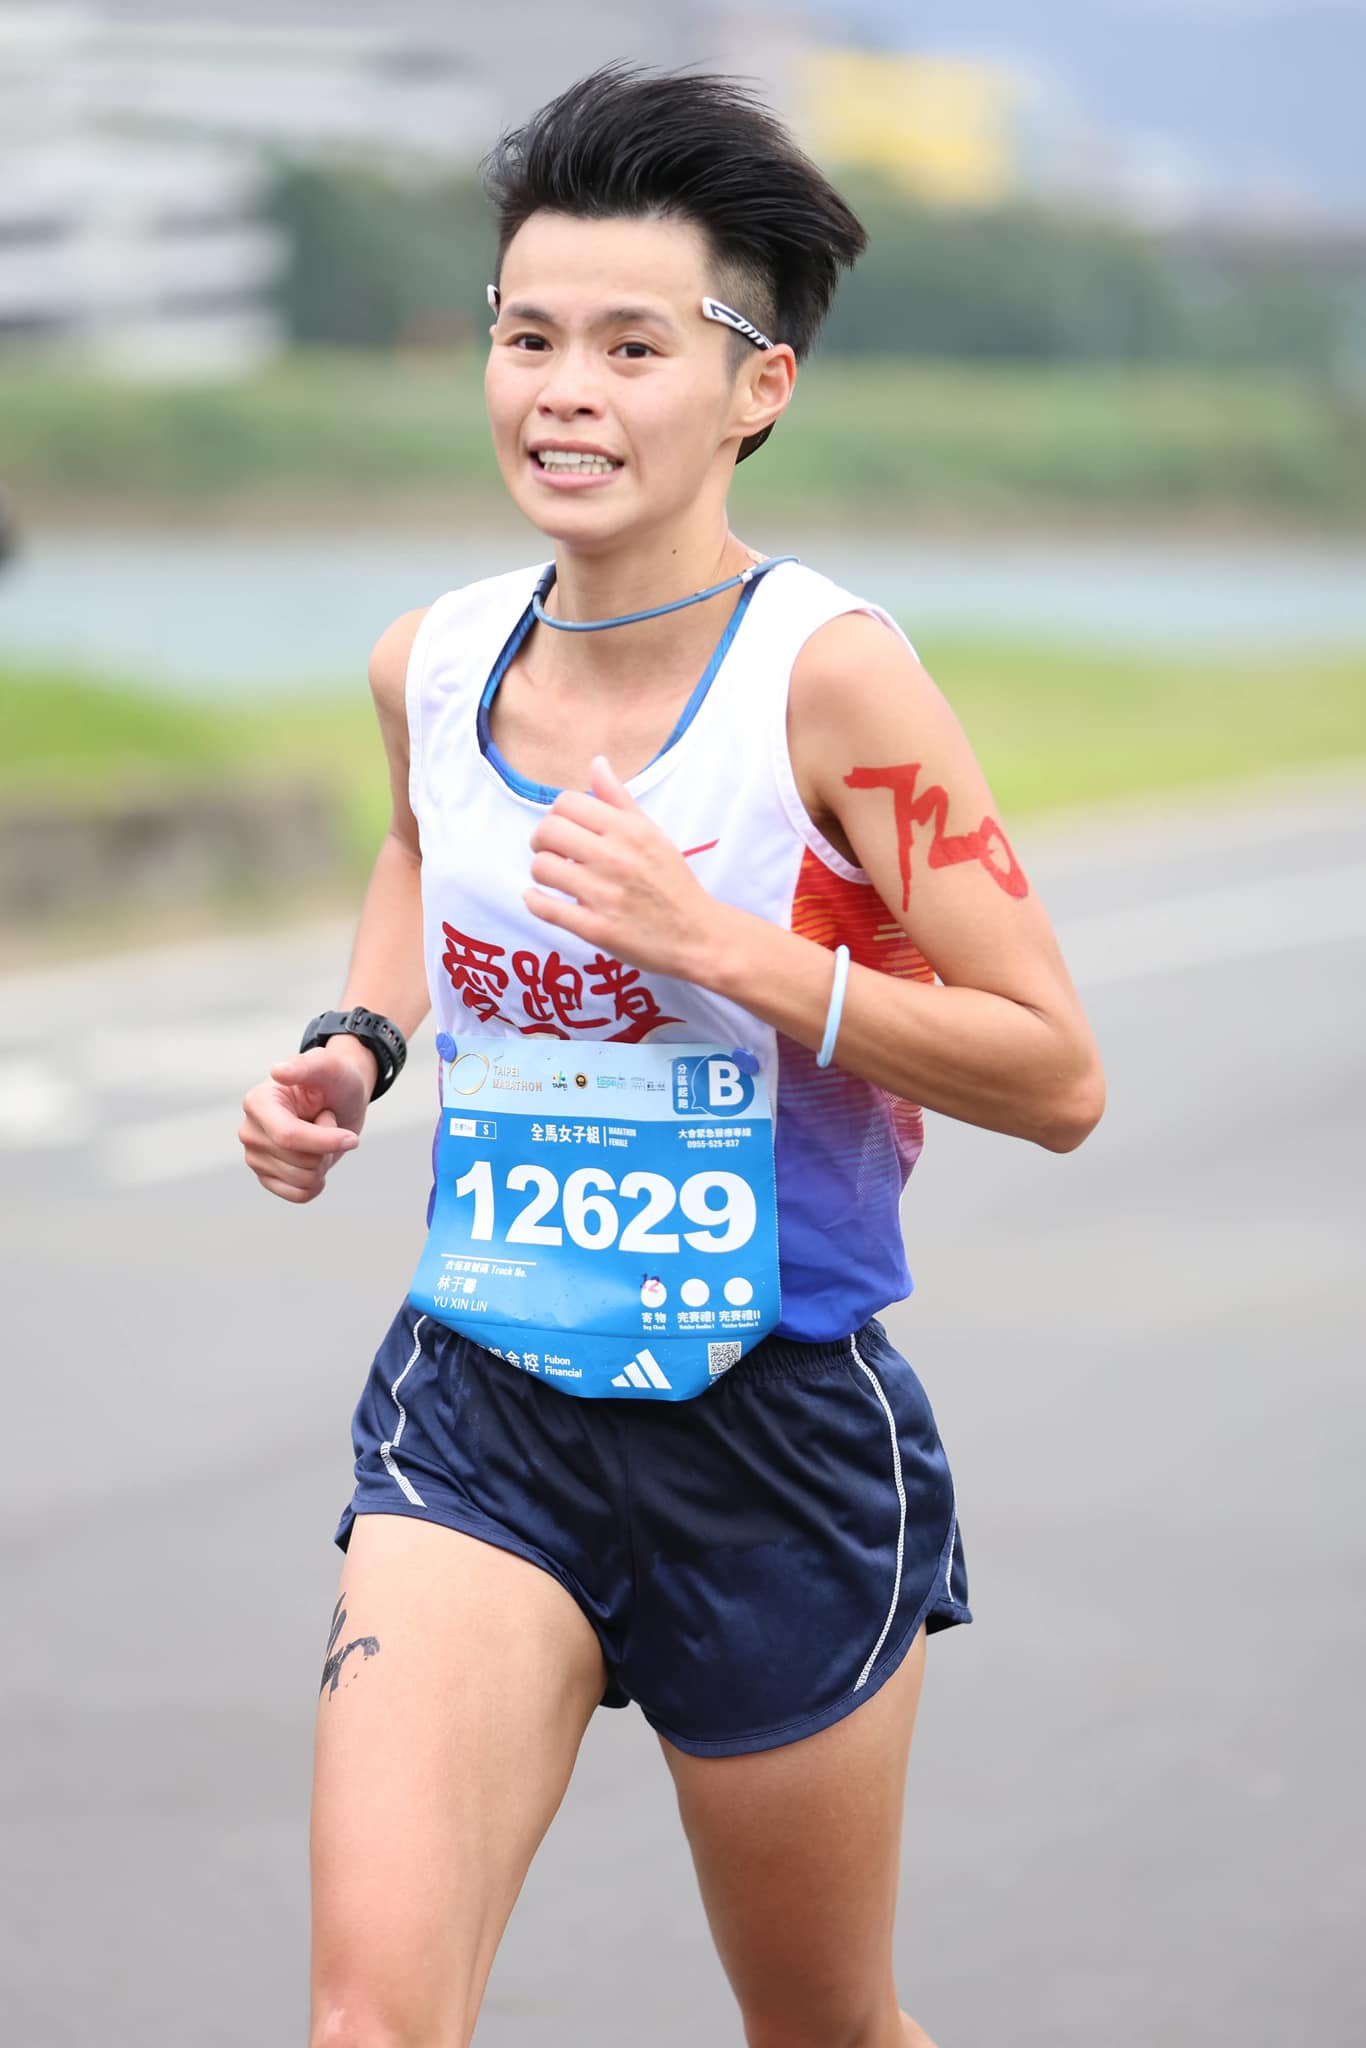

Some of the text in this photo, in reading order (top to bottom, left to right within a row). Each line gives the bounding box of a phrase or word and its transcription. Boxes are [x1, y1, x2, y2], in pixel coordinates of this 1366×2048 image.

[442, 921, 672, 1032] 愛跑者
[493, 1064, 520, 1077] TAIPEI
[493, 1079, 543, 1092] MARATHON
[708, 1060, 745, 1107] B
[482, 1124, 490, 1136] S
[531, 1123, 600, 1144] 全馬女子組
[456, 1160, 757, 1254] 12629
[433, 1296, 488, 1312] YU XIN LIN
[544, 1354, 571, 1366] Fubon
[544, 1365, 583, 1378] Financial
